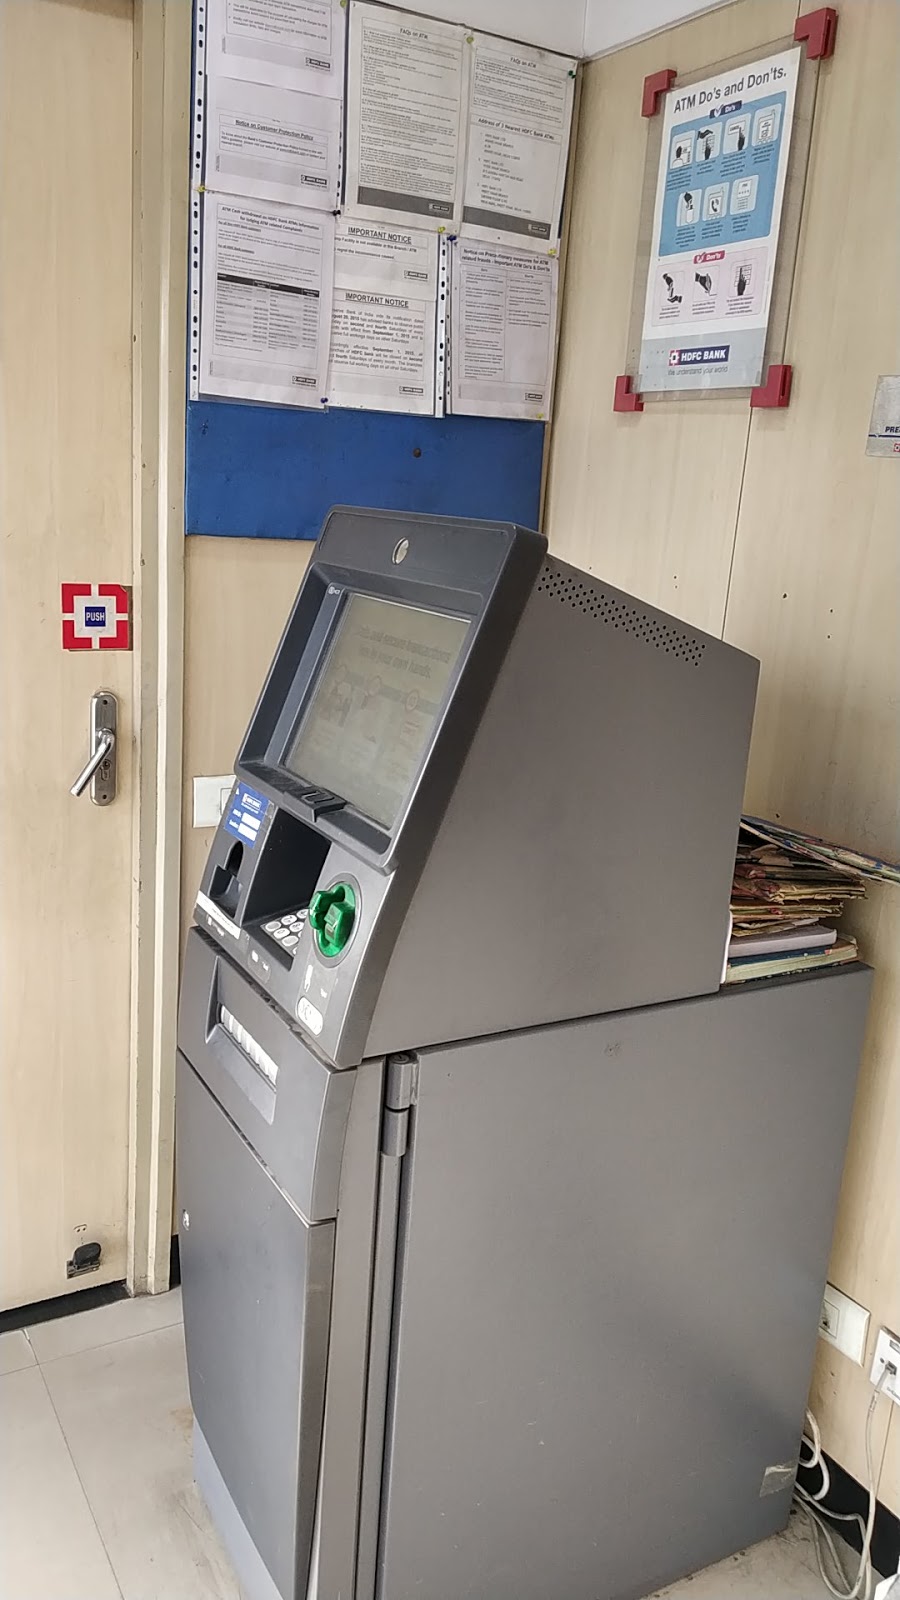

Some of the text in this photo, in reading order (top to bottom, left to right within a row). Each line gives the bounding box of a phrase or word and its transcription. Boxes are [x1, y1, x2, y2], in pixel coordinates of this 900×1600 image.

[400, 28, 412, 36] FAQs
[674, 67, 786, 113] ATM Do's and Don'ts.
[258, 123, 278, 133] Customer
[279, 128, 300, 137] Protection
[301, 133, 314, 141] Policy
[478, 118, 494, 126] Address
[505, 124, 520, 132] Nearest
[522, 127, 533, 135] HDFC
[283, 224, 303, 233] Complaints
[299, 221, 319, 230] Information
[348, 227, 412, 243] IMPORTANT NOTICE
[485, 252, 512, 261] Precationary
[346, 293, 409, 307] IMPORTANT NOTICE
[681, 349, 726, 362] HDFC BANK
[86, 612, 104, 621] PUSH
